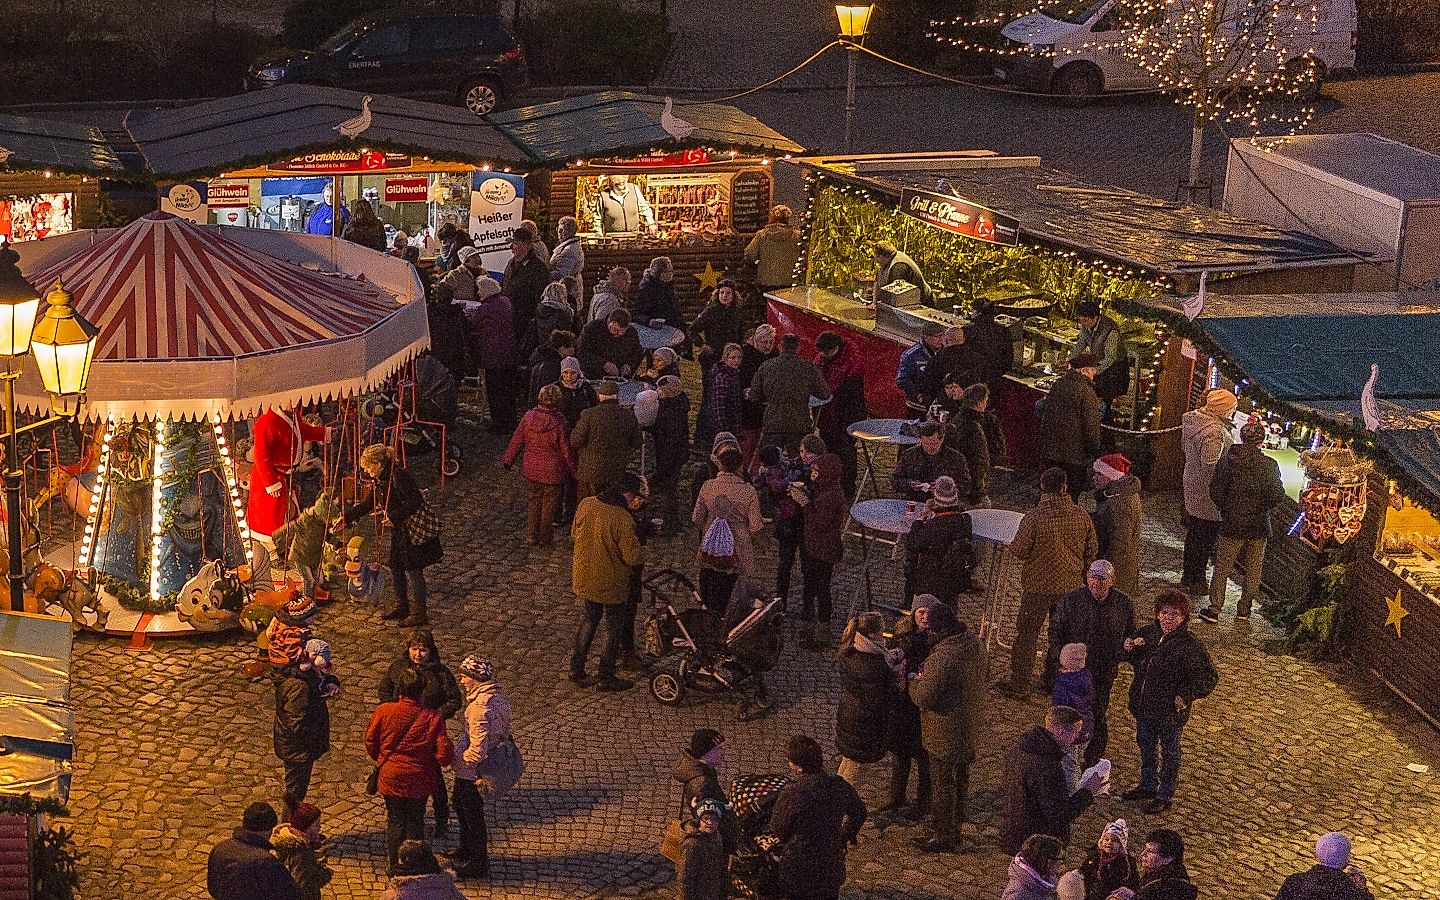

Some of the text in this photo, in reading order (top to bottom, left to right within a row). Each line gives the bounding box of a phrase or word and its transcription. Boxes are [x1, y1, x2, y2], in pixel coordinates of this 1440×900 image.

[207, 187, 248, 198] Glühwein
[386, 183, 427, 195] Glühwein
[910, 195, 970, 224] Grill & Pfanne
[478, 212, 513, 225] Heißer
[474, 227, 515, 244] Apfelsaft
